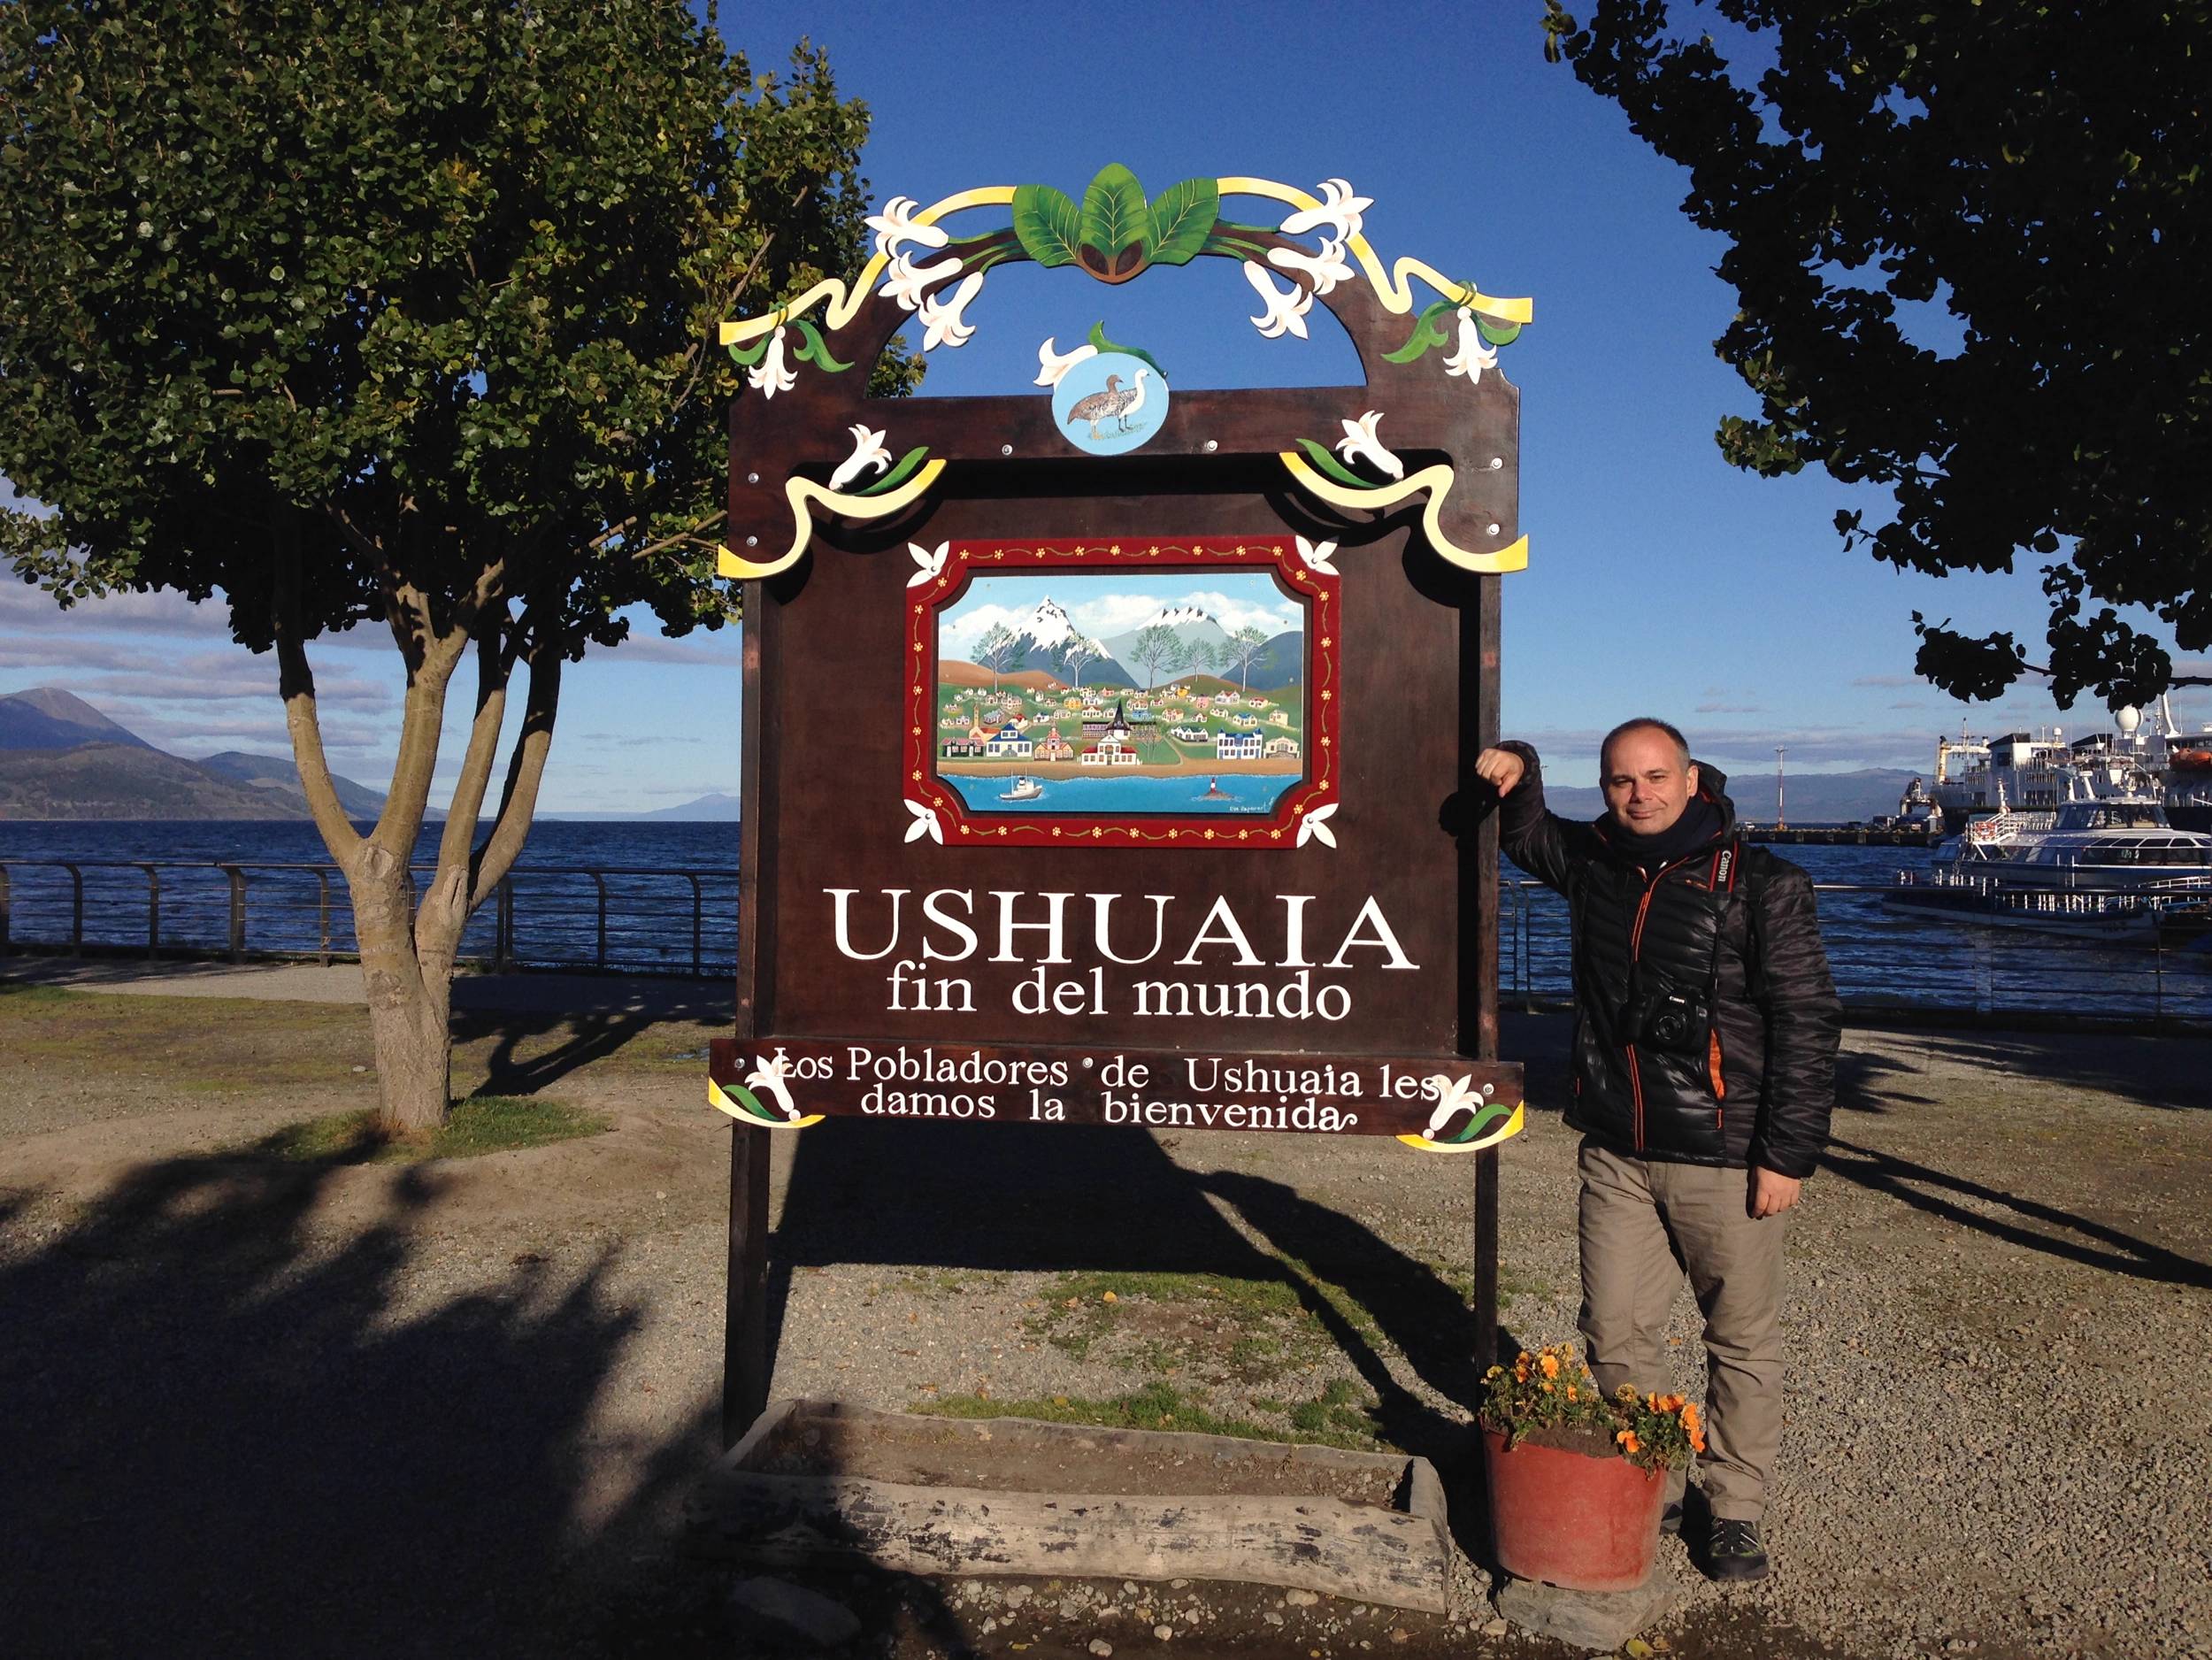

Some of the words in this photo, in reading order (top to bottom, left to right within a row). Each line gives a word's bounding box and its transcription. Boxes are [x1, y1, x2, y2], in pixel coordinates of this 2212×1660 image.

[1717, 849, 1732, 882] Canon
[822, 888, 1421, 970] USHUAIA
[886, 959, 978, 1012] fin
[1011, 964, 1109, 1016] del
[1132, 969, 1352, 1021] mundo
[773, 1047, 833, 1080] Los
[846, 1046, 1069, 1087] Pobladores
[1101, 1054, 1149, 1088] de
[1183, 1057, 1363, 1097] Ushuaia
[1379, 1064, 1440, 1102] les
[860, 1082, 995, 1118] damos
[1029, 1087, 1066, 1121] la
[1100, 1090, 1358, 1132] bienvenida
